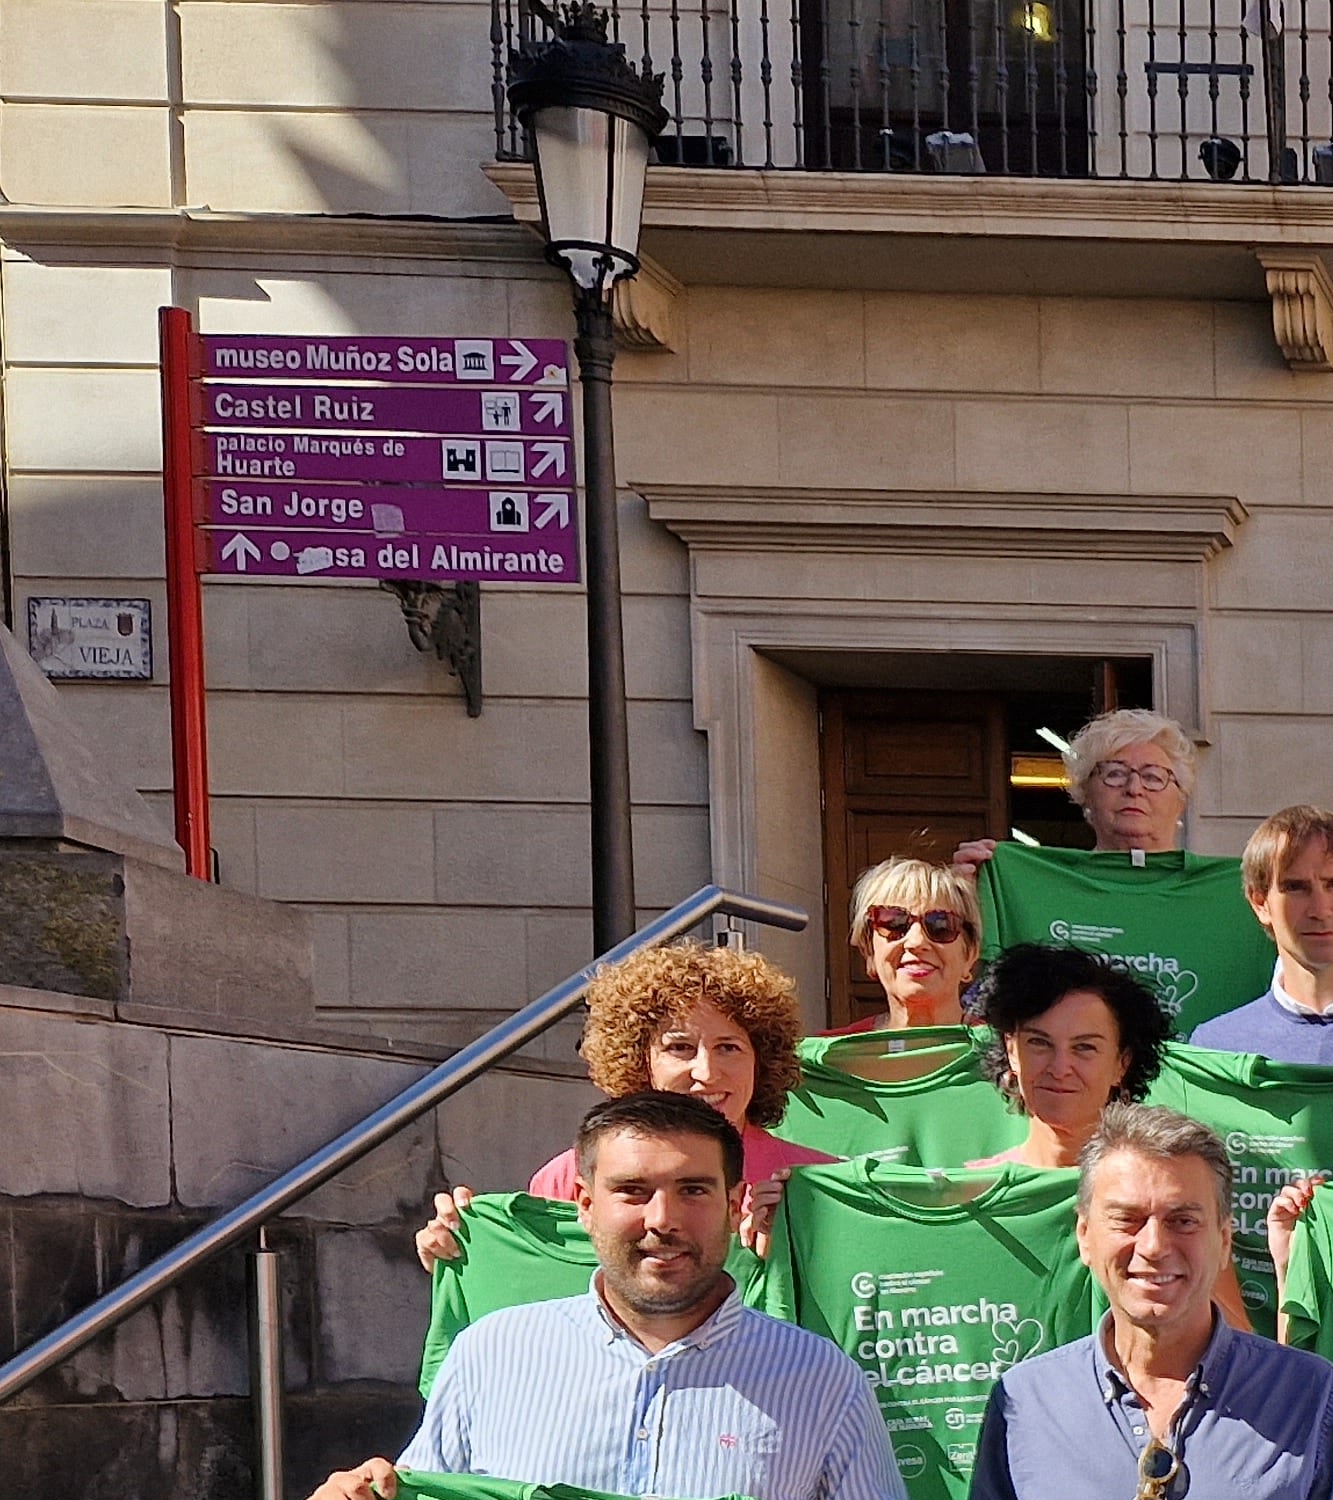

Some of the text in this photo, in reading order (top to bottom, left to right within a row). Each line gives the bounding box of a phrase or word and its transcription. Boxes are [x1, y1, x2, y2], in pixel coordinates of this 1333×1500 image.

[215, 344, 453, 372] museo Muñoz Sola
[215, 392, 374, 421] Castel Ruiz
[217, 435, 405, 458] palacio Marqués de
[217, 453, 295, 476] Huarte
[221, 489, 363, 523] San Jorge
[377, 544, 419, 569] del
[431, 544, 564, 573] Almirante
[79, 646, 134, 665] VIEJA
[854, 1297, 1018, 1331] En marcha
[858, 1331, 959, 1360] contra
[897, 1359, 1001, 1385] cáncer
